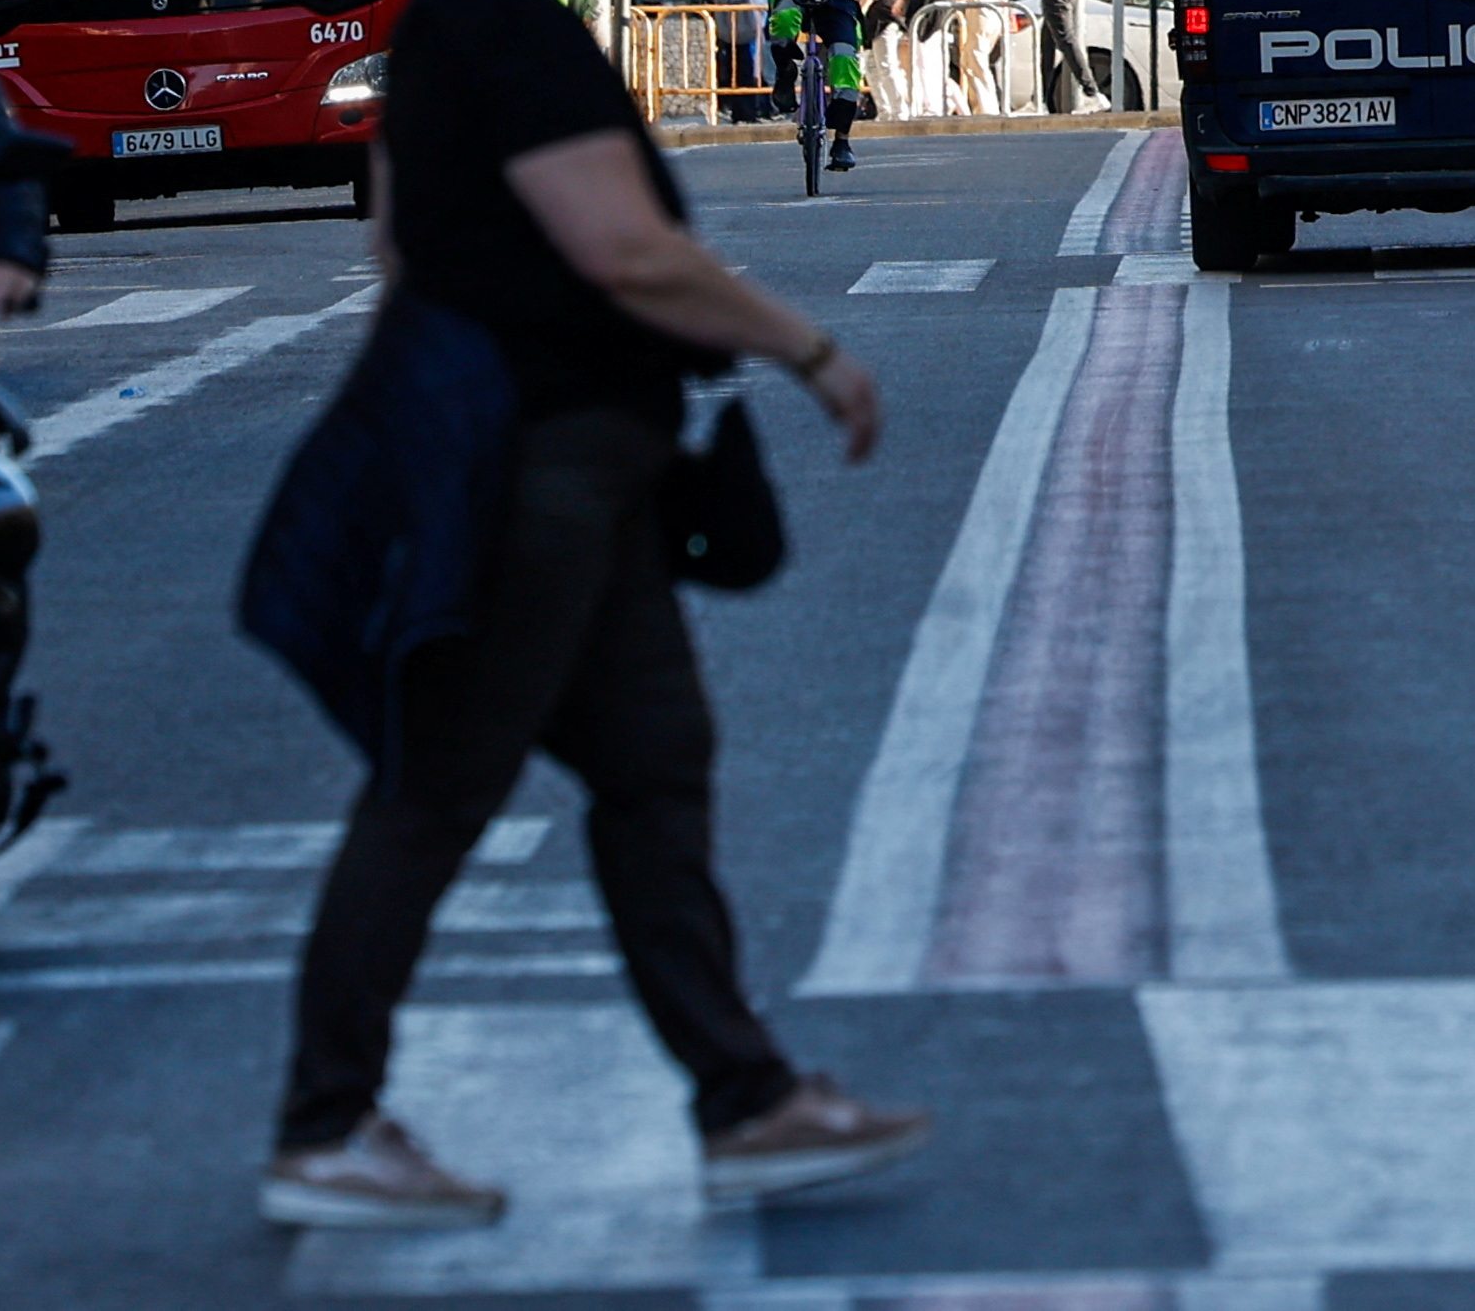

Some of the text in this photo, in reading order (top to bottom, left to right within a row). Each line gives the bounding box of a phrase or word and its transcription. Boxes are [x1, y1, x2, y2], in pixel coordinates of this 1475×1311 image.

[310, 21, 363, 44] 6470
[126, 127, 218, 152] 6479 LLG
